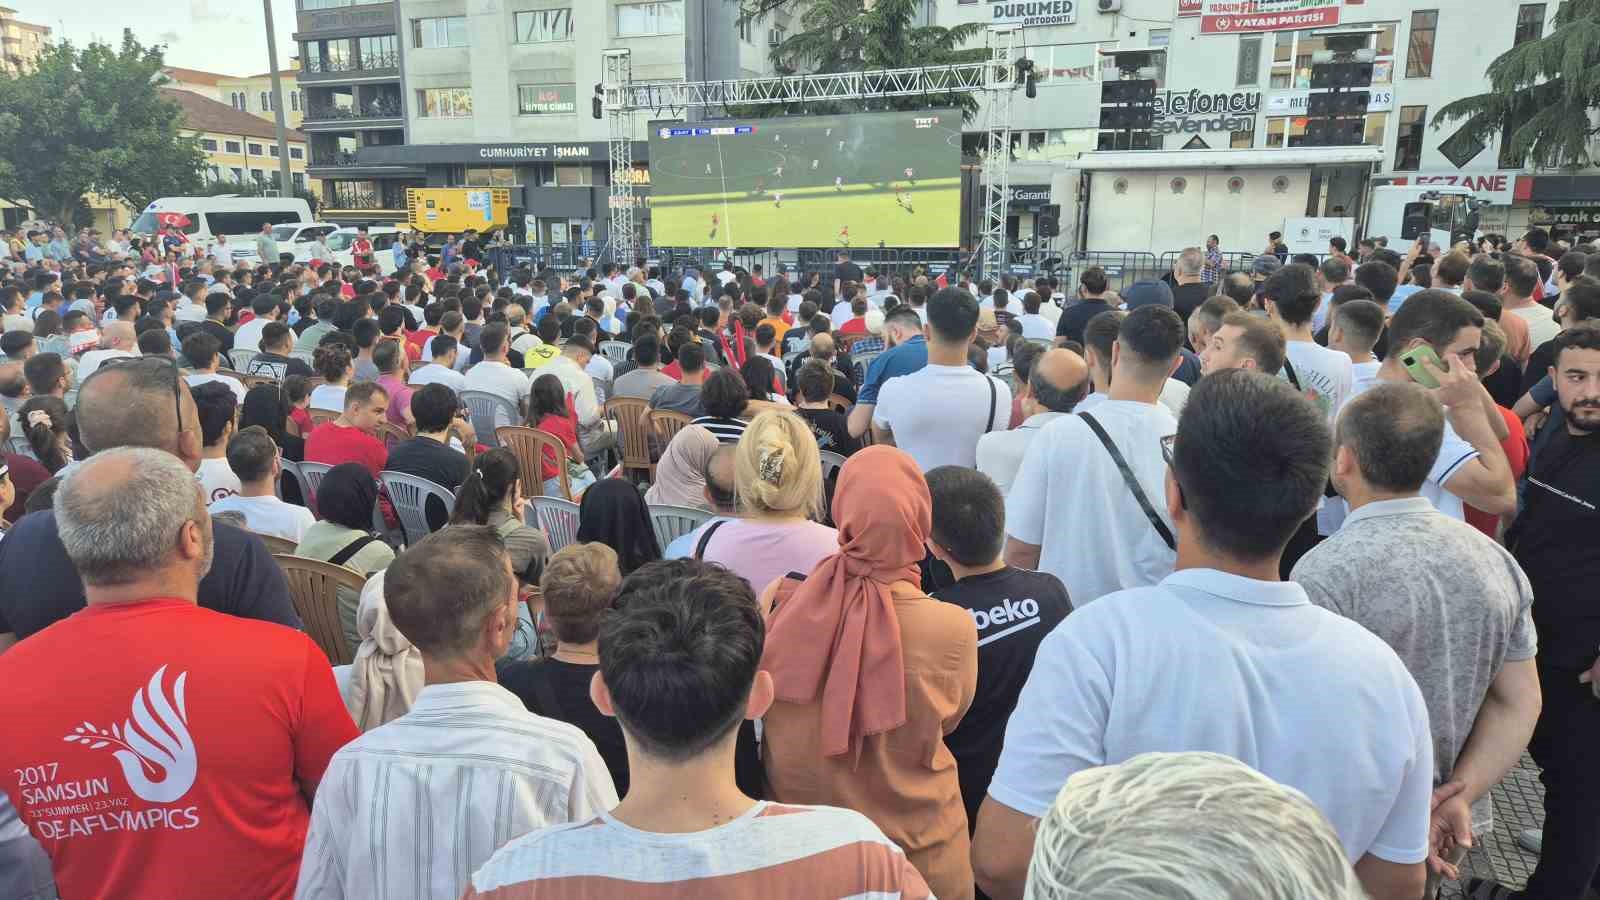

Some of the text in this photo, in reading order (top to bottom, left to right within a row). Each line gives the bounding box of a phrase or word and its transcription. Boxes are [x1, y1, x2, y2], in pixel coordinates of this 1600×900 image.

[993, 1, 1073, 18] DURUMED
[1234, 16, 1277, 27] VATAN
[1152, 88, 1261, 116] elefoncu
[480, 145, 590, 158] CUMHURİYET İŞHANI
[1015, 189, 1050, 200] Garanti
[14, 762, 59, 786] 2017
[22, 777, 110, 806] SAMSUN
[37, 806, 201, 840] DEAFLYMPICS
